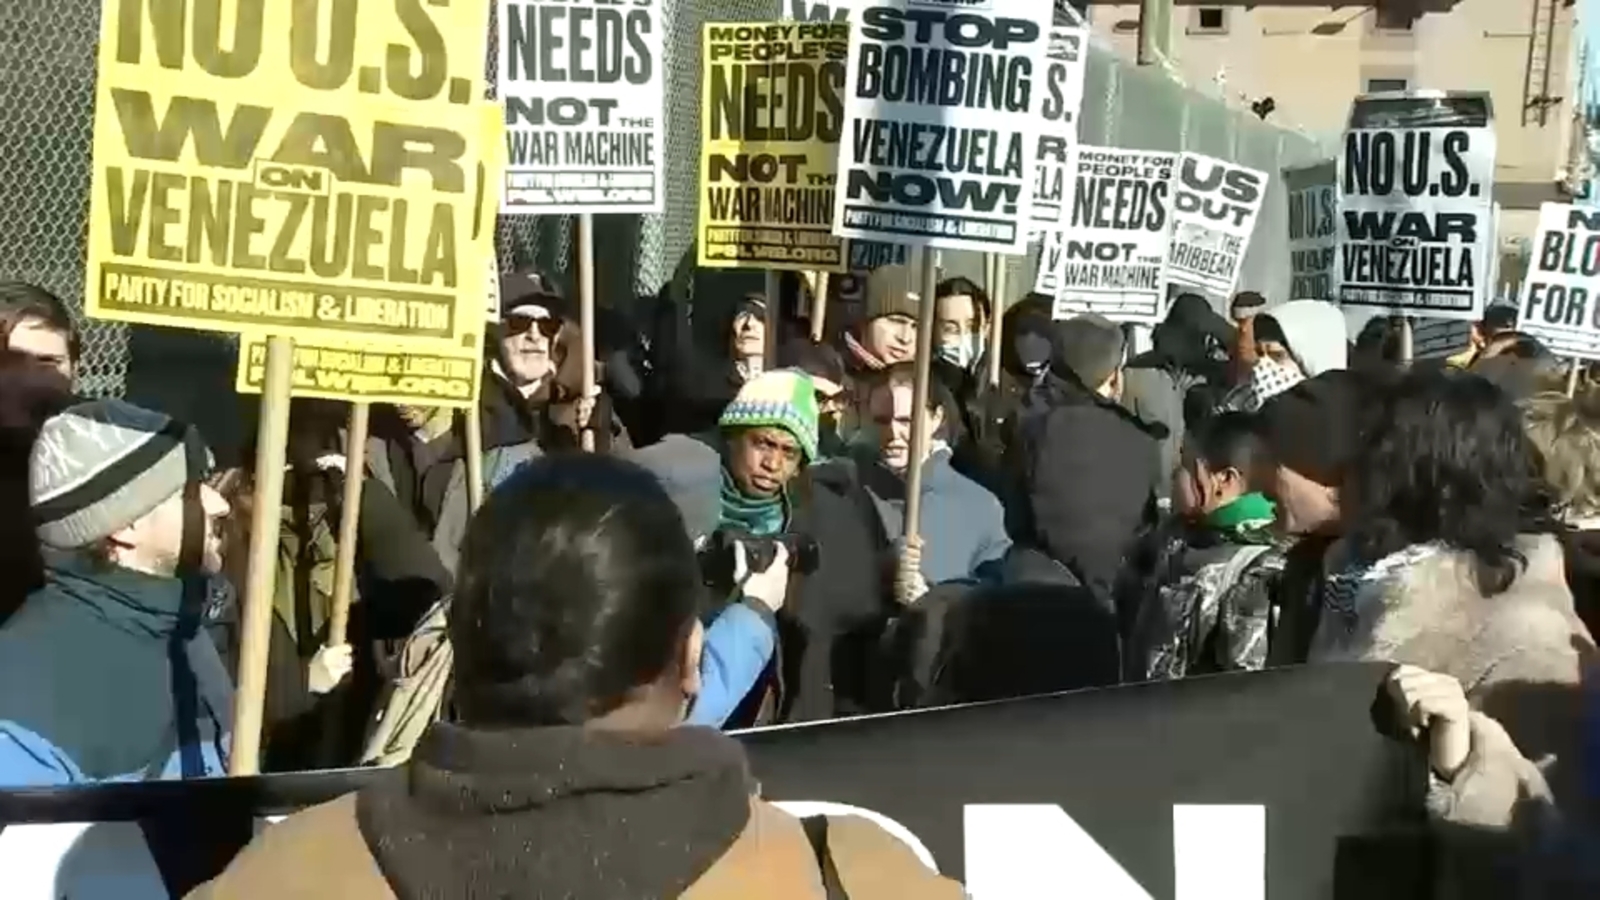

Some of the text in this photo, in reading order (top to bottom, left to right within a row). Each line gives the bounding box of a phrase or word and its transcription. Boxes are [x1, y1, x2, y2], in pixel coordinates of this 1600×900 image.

[507, 3, 652, 85] NEEDS
[709, 24, 848, 41] MONEY FOR
[862, 7, 1039, 49] STOP
[290, 0, 471, 104] U.S.
[710, 42, 848, 61] PEOPLE'S
[856, 43, 1032, 113] BOMBING
[505, 96, 654, 127] NOT THE
[710, 61, 847, 142] NEEDS
[110, 87, 466, 193] WAR
[506, 130, 654, 167] WAR MACHINE
[853, 118, 1023, 179] VENEZUELA
[259, 166, 322, 191] ON
[708, 154, 807, 184] NOT
[1078, 163, 1172, 180] PEOPLES
[1079, 152, 1174, 167] MONEY FOR
[1345, 130, 1480, 197] NO U.S.
[847, 170, 1021, 214] NOW!
[1181, 156, 1261, 203] US
[708, 187, 761, 222] WAR
[1071, 176, 1168, 232] NEEDS
[1175, 191, 1253, 227] OUT
[1567, 210, 1600, 231] N
[106, 166, 458, 288] VENEZUELA
[945, 219, 957, 234] &
[1343, 210, 1478, 242] WAR
[1392, 238, 1416, 246] ON
[1067, 240, 1137, 262] NOT
[1170, 240, 1237, 278] RIBBEAN
[1342, 244, 1474, 287] VENEZUELA
[1538, 230, 1600, 277] BLO
[1065, 262, 1099, 287] WAR
[1102, 264, 1160, 289] MACHINE
[105, 273, 450, 330] PARTY FOR SOCIALISM & LIBERATION
[1524, 282, 1588, 326] FOR
